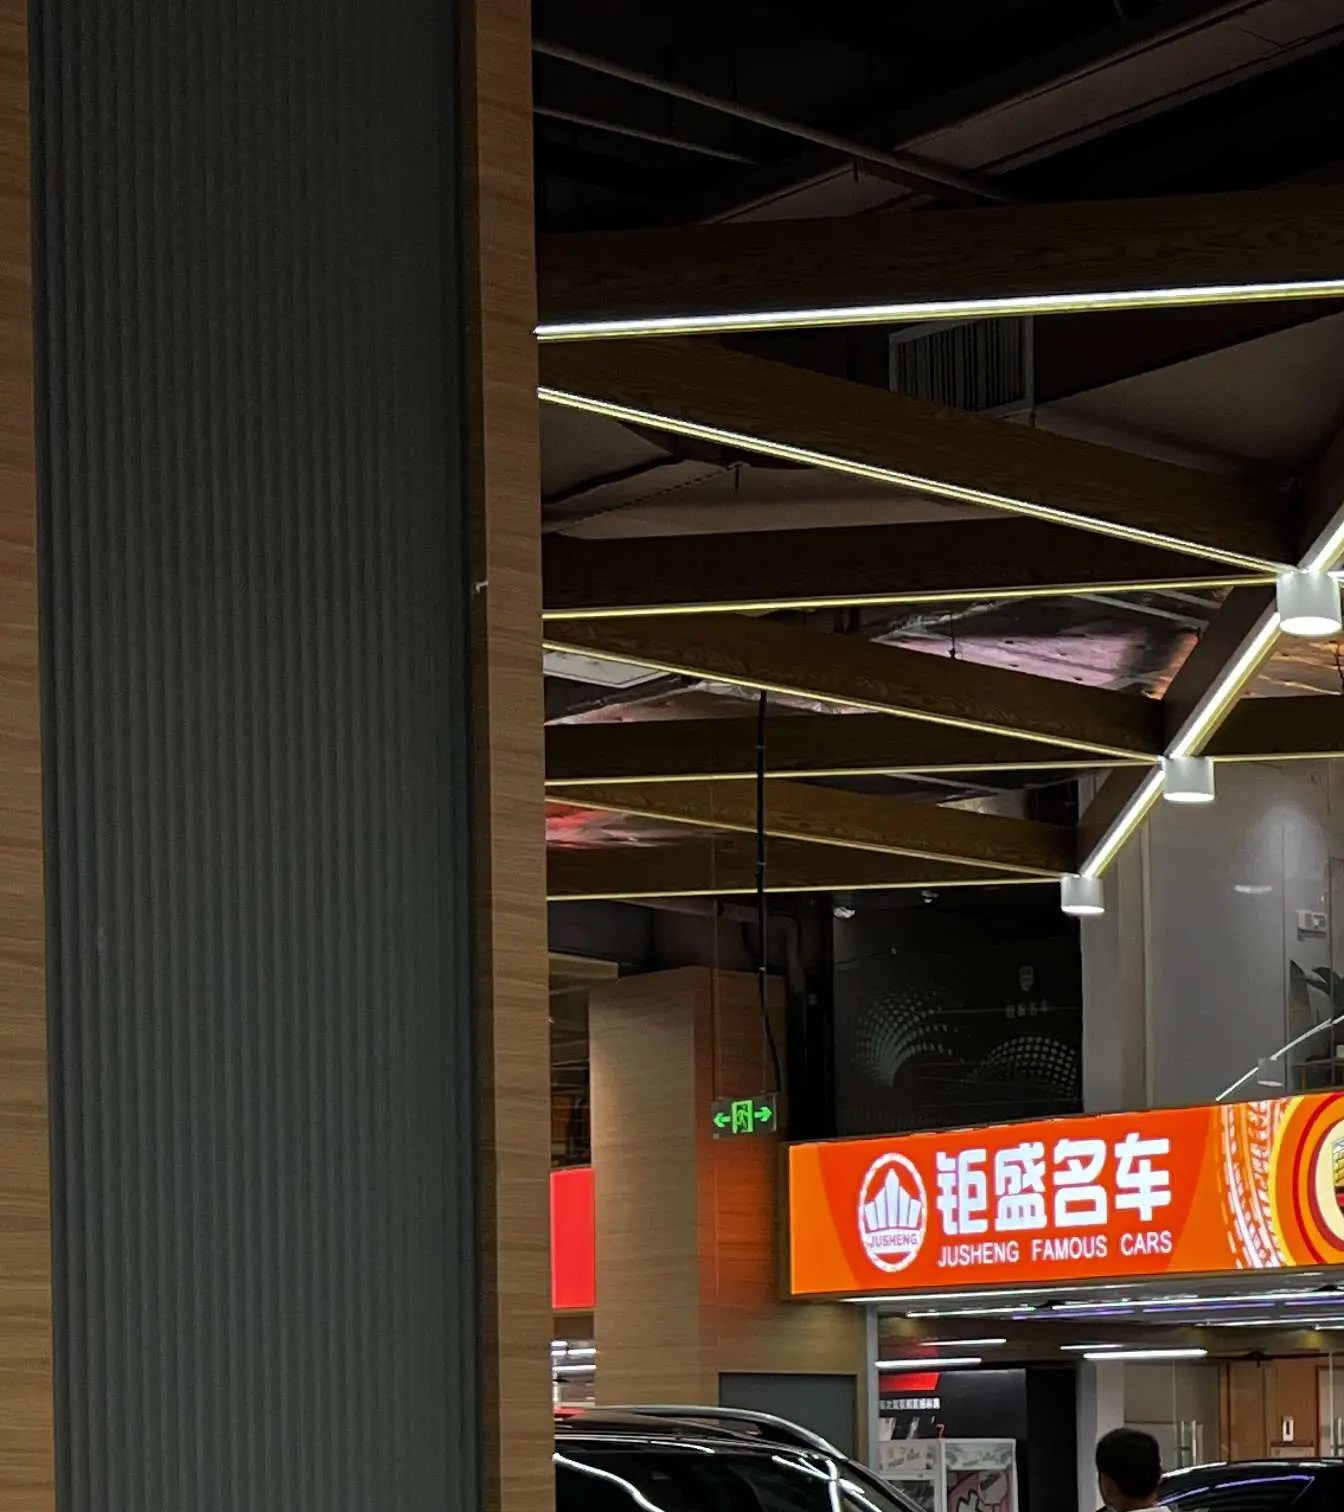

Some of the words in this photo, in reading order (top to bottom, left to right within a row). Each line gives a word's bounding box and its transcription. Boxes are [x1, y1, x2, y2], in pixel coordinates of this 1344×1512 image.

[935, 1132, 1172, 1236] 钜盛名车
[866, 1233, 918, 1247] JUSHENG
[937, 1240, 1020, 1268] JUSHENG
[1032, 1235, 1108, 1261] FAMOUS
[1120, 1230, 1173, 1256] CARS
